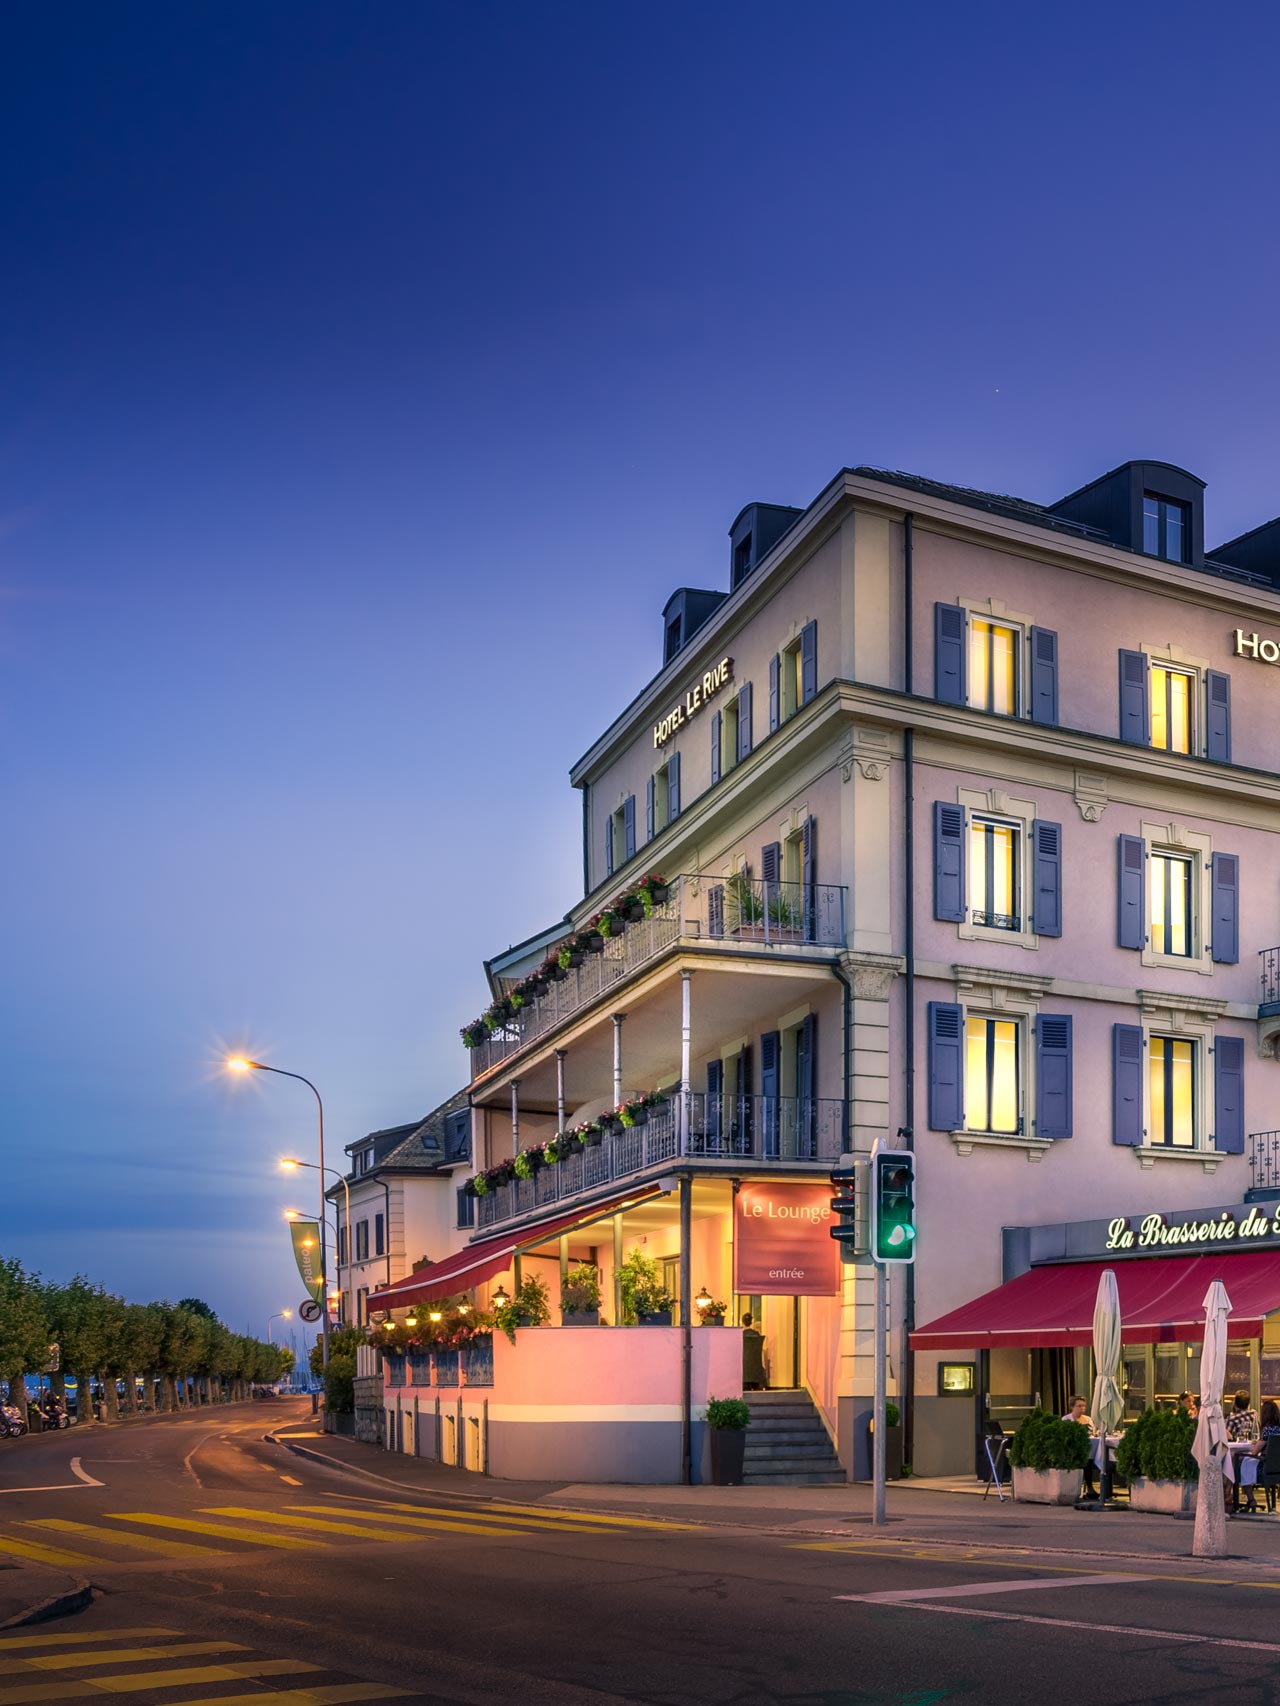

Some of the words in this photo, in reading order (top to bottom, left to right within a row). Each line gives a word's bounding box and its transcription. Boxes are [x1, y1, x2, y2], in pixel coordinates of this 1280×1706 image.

[653, 704, 685, 749] HOTEL
[686, 685, 701, 716] LE
[703, 657, 730, 699] RIVE
[743, 1201, 763, 1217] Le
[768, 1201, 831, 1225] Lounge
[1105, 1217, 1134, 1249] La
[1138, 1212, 1235, 1247] Brasserie
[1238, 1207, 1268, 1237] du
[768, 1267, 805, 1279] entrée
